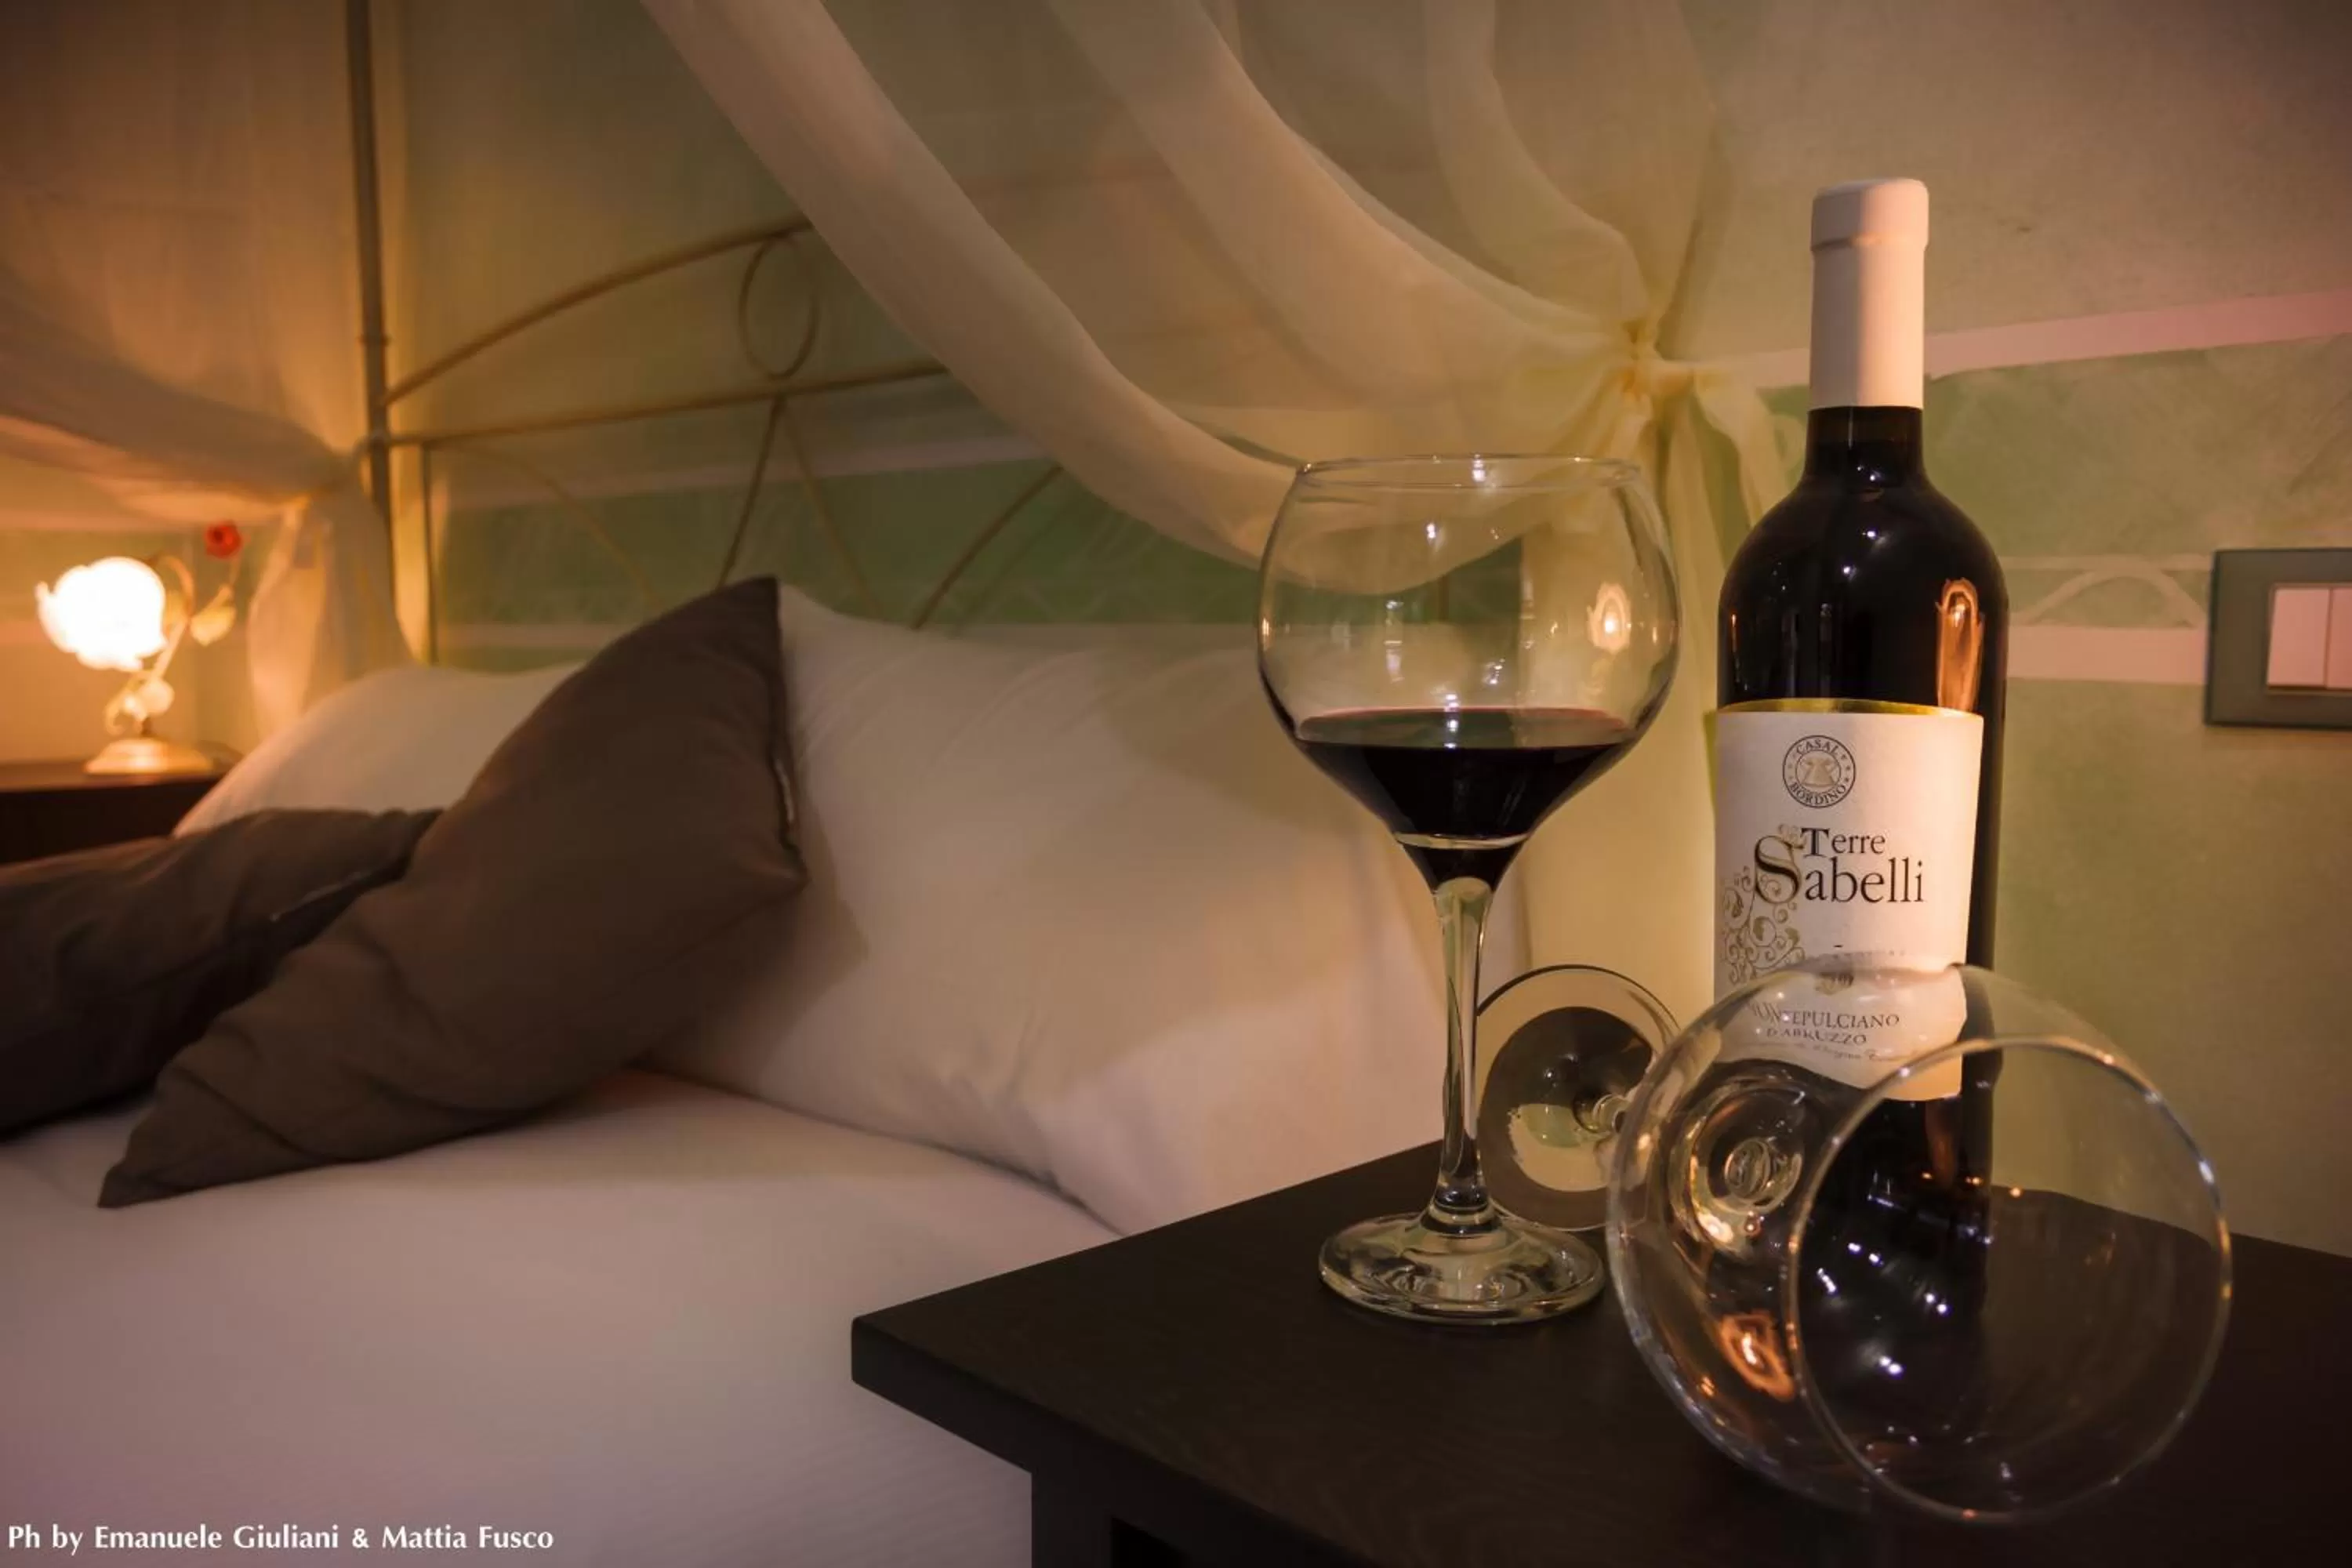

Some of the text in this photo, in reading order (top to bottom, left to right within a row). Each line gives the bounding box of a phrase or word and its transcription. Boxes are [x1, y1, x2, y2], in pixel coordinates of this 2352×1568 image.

[1795, 739, 1839, 756] CASAL
[1789, 782, 1847, 804] BORDINO
[1801, 827, 1886, 858] Terre
[1754, 834, 1926, 904] Sabelli
